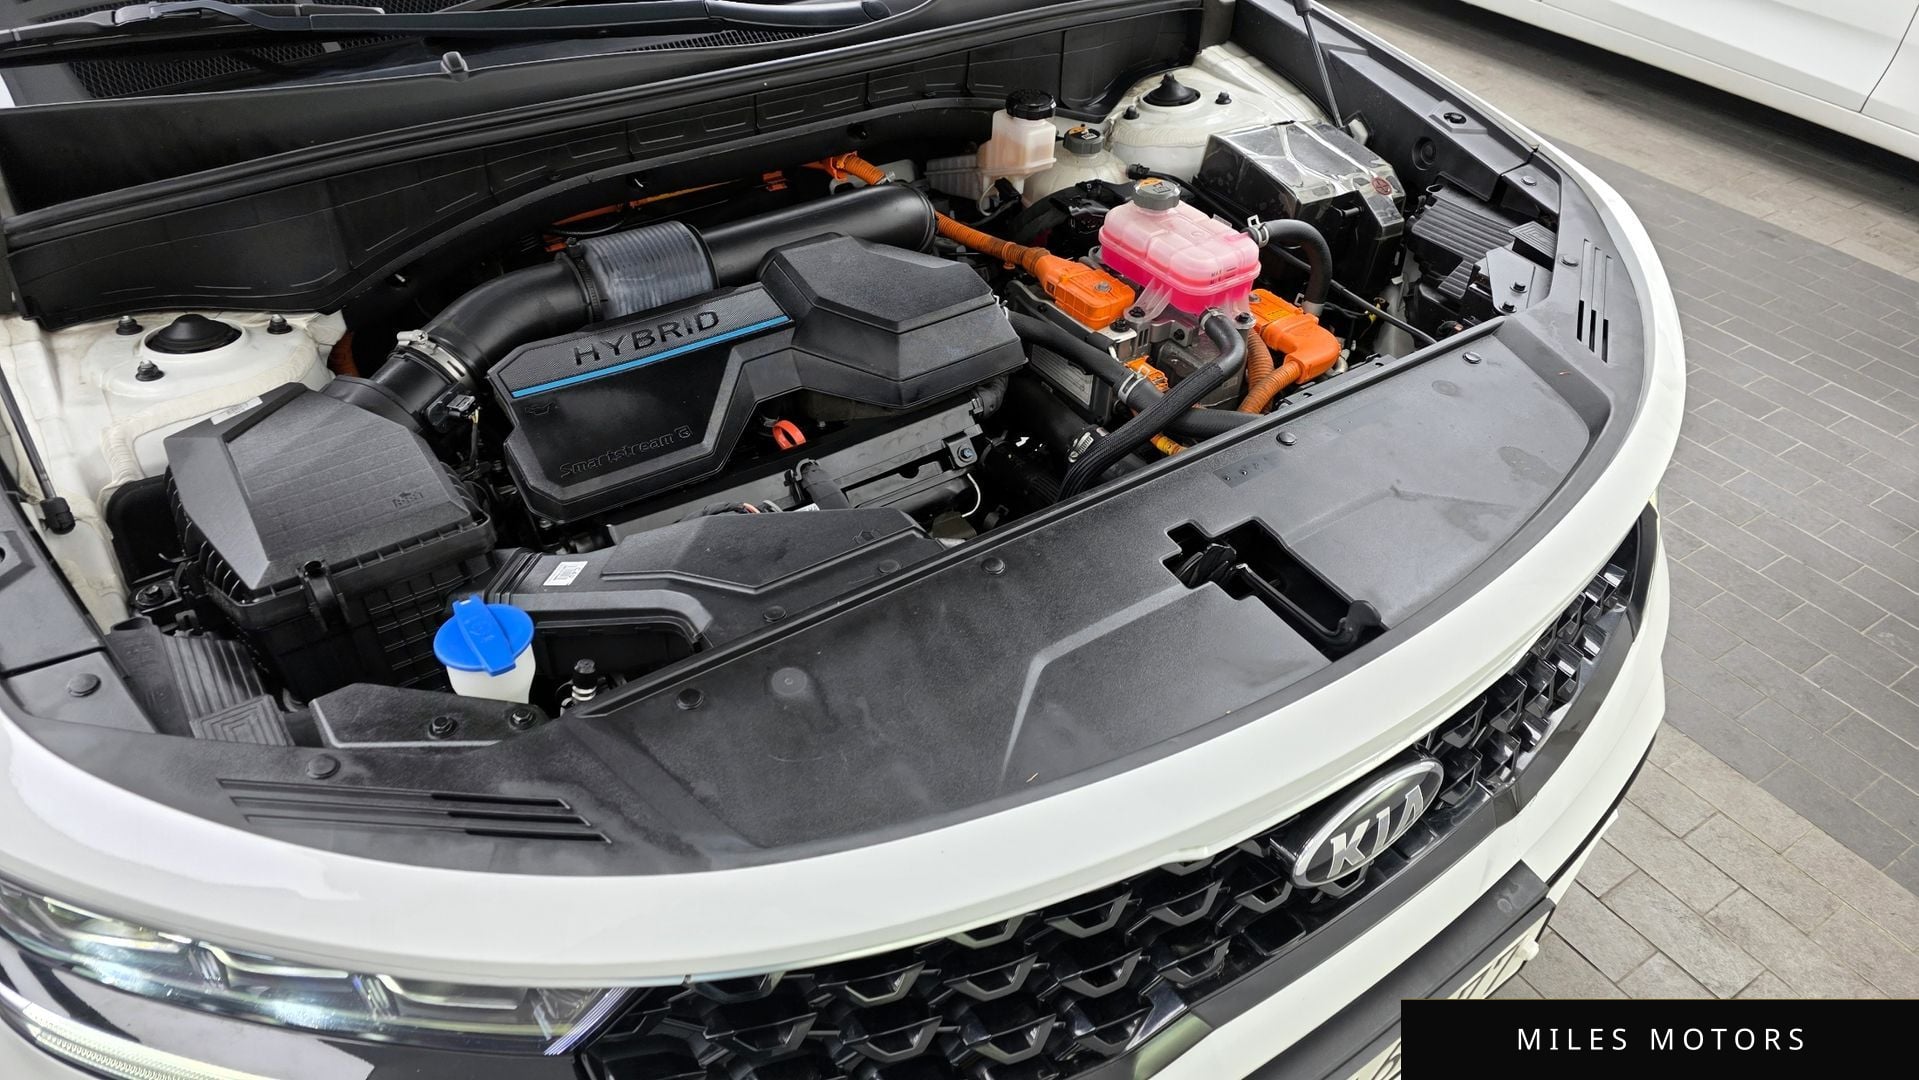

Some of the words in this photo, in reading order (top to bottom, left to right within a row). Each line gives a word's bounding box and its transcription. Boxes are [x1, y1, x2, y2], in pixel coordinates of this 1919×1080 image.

[573, 311, 719, 366] HYBRID
[559, 433, 674, 478] Smartstream
[1327, 784, 1424, 879] KIA
